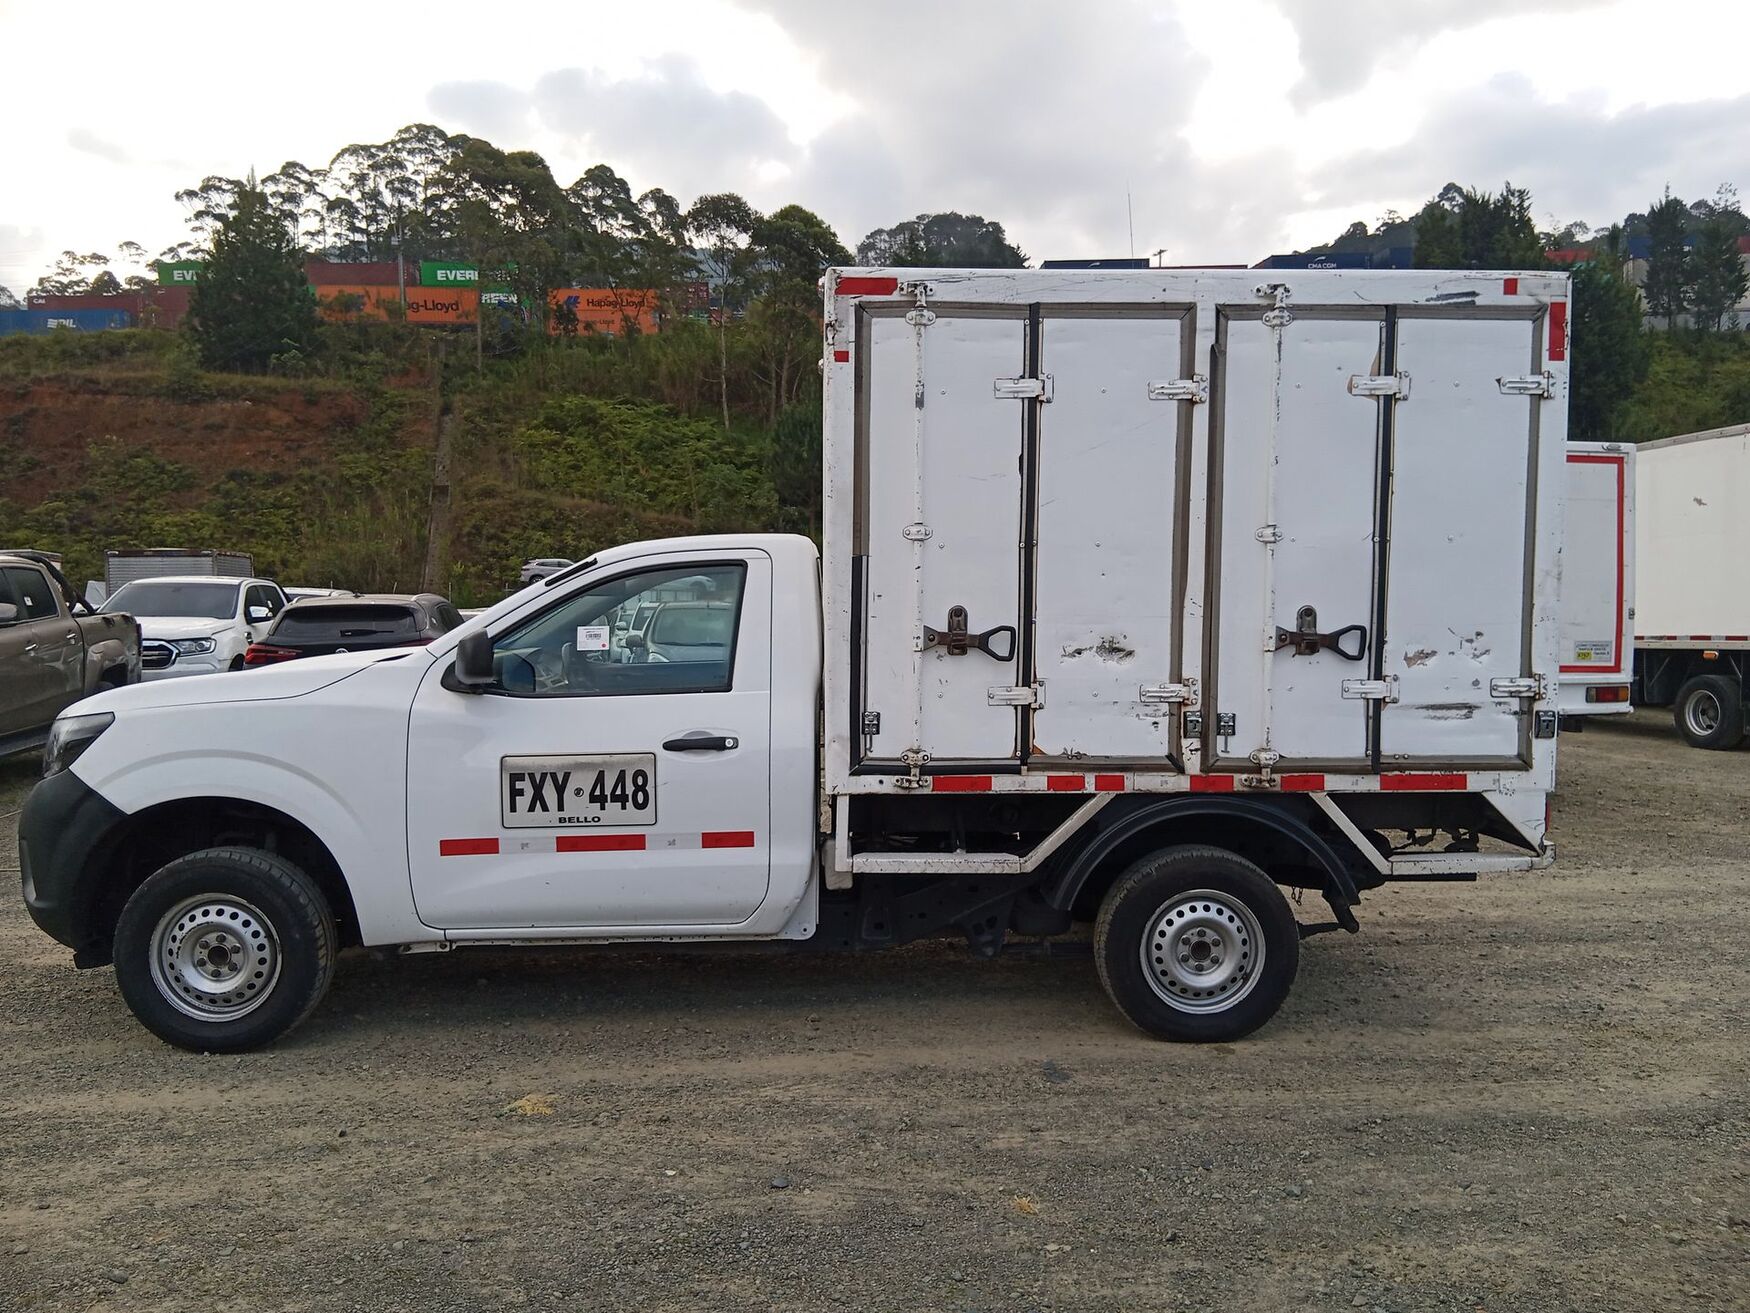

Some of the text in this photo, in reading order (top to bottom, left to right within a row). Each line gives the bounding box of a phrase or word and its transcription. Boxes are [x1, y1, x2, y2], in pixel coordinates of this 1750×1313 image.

[586, 298, 645, 308] Hapag-Lloyd
[509, 769, 650, 813] FXY 448
[558, 816, 601, 824] BELLO
